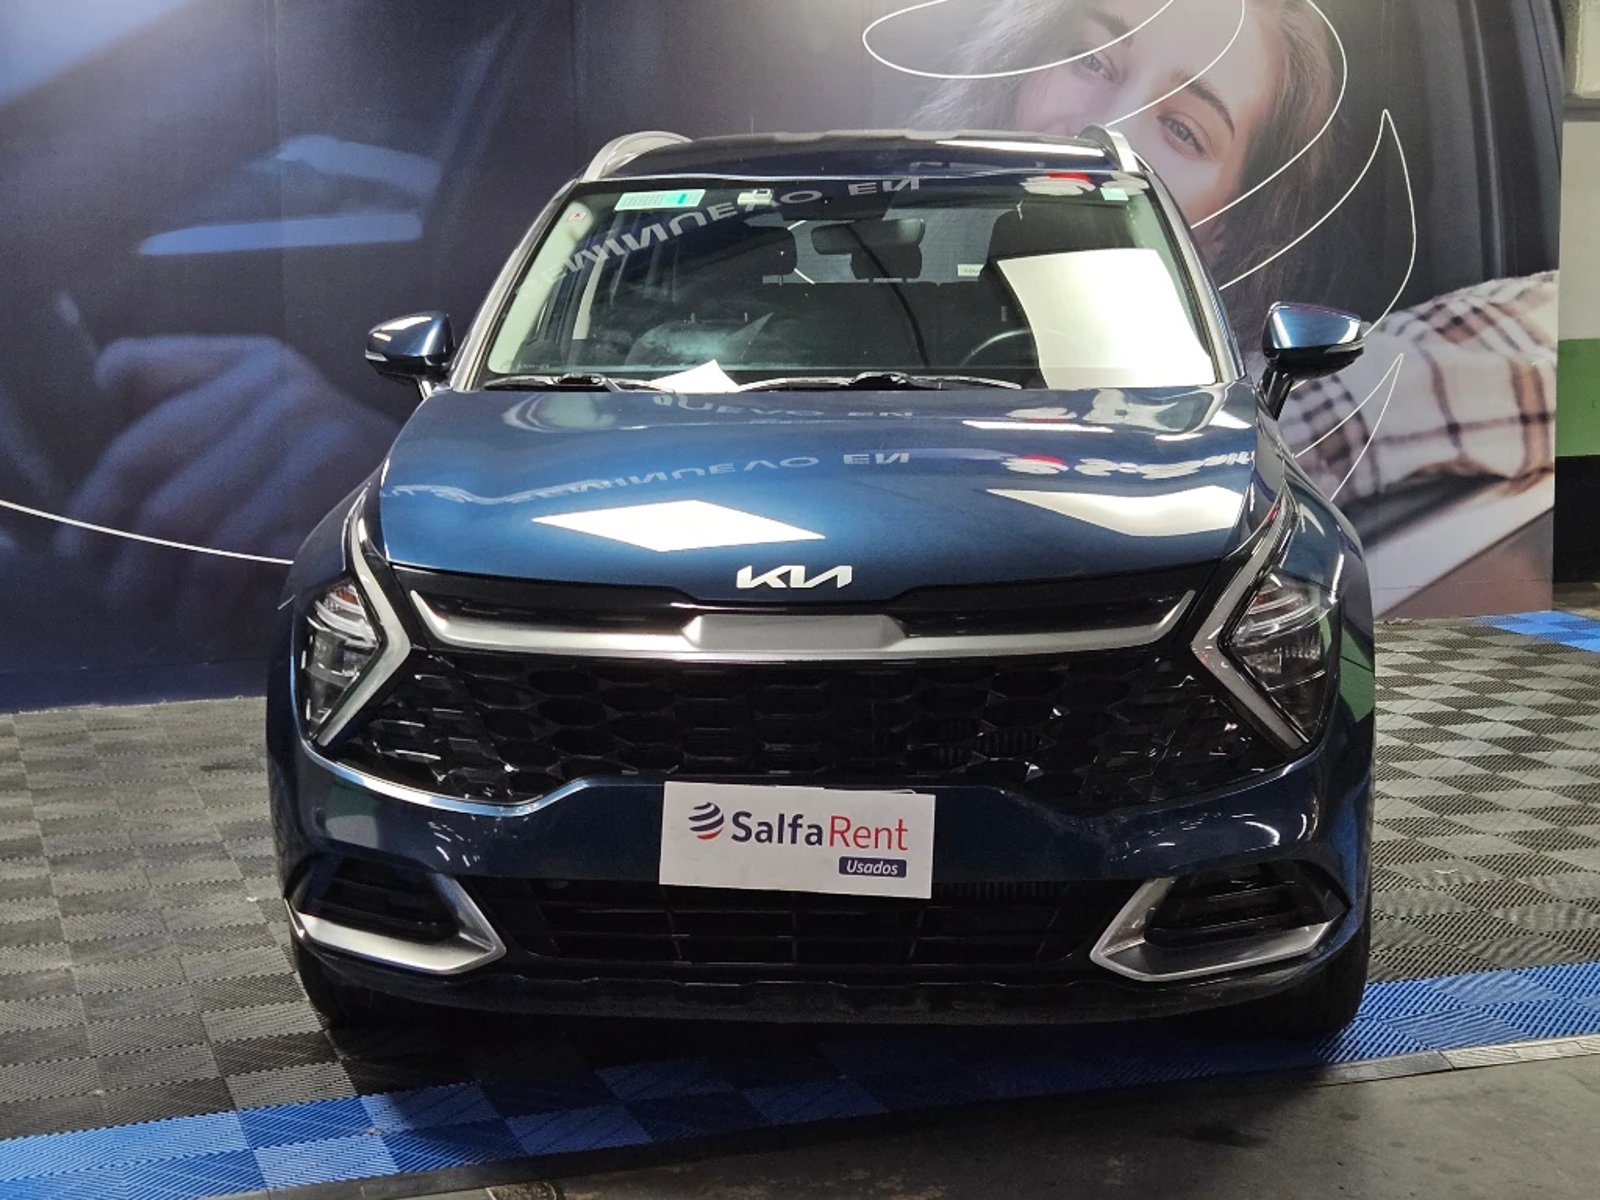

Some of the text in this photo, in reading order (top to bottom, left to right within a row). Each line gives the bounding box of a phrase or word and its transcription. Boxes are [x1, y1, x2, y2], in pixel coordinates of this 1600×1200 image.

[736, 565, 853, 589] KIA
[730, 810, 909, 851] SalfaRent
[846, 859, 899, 876] Usados
